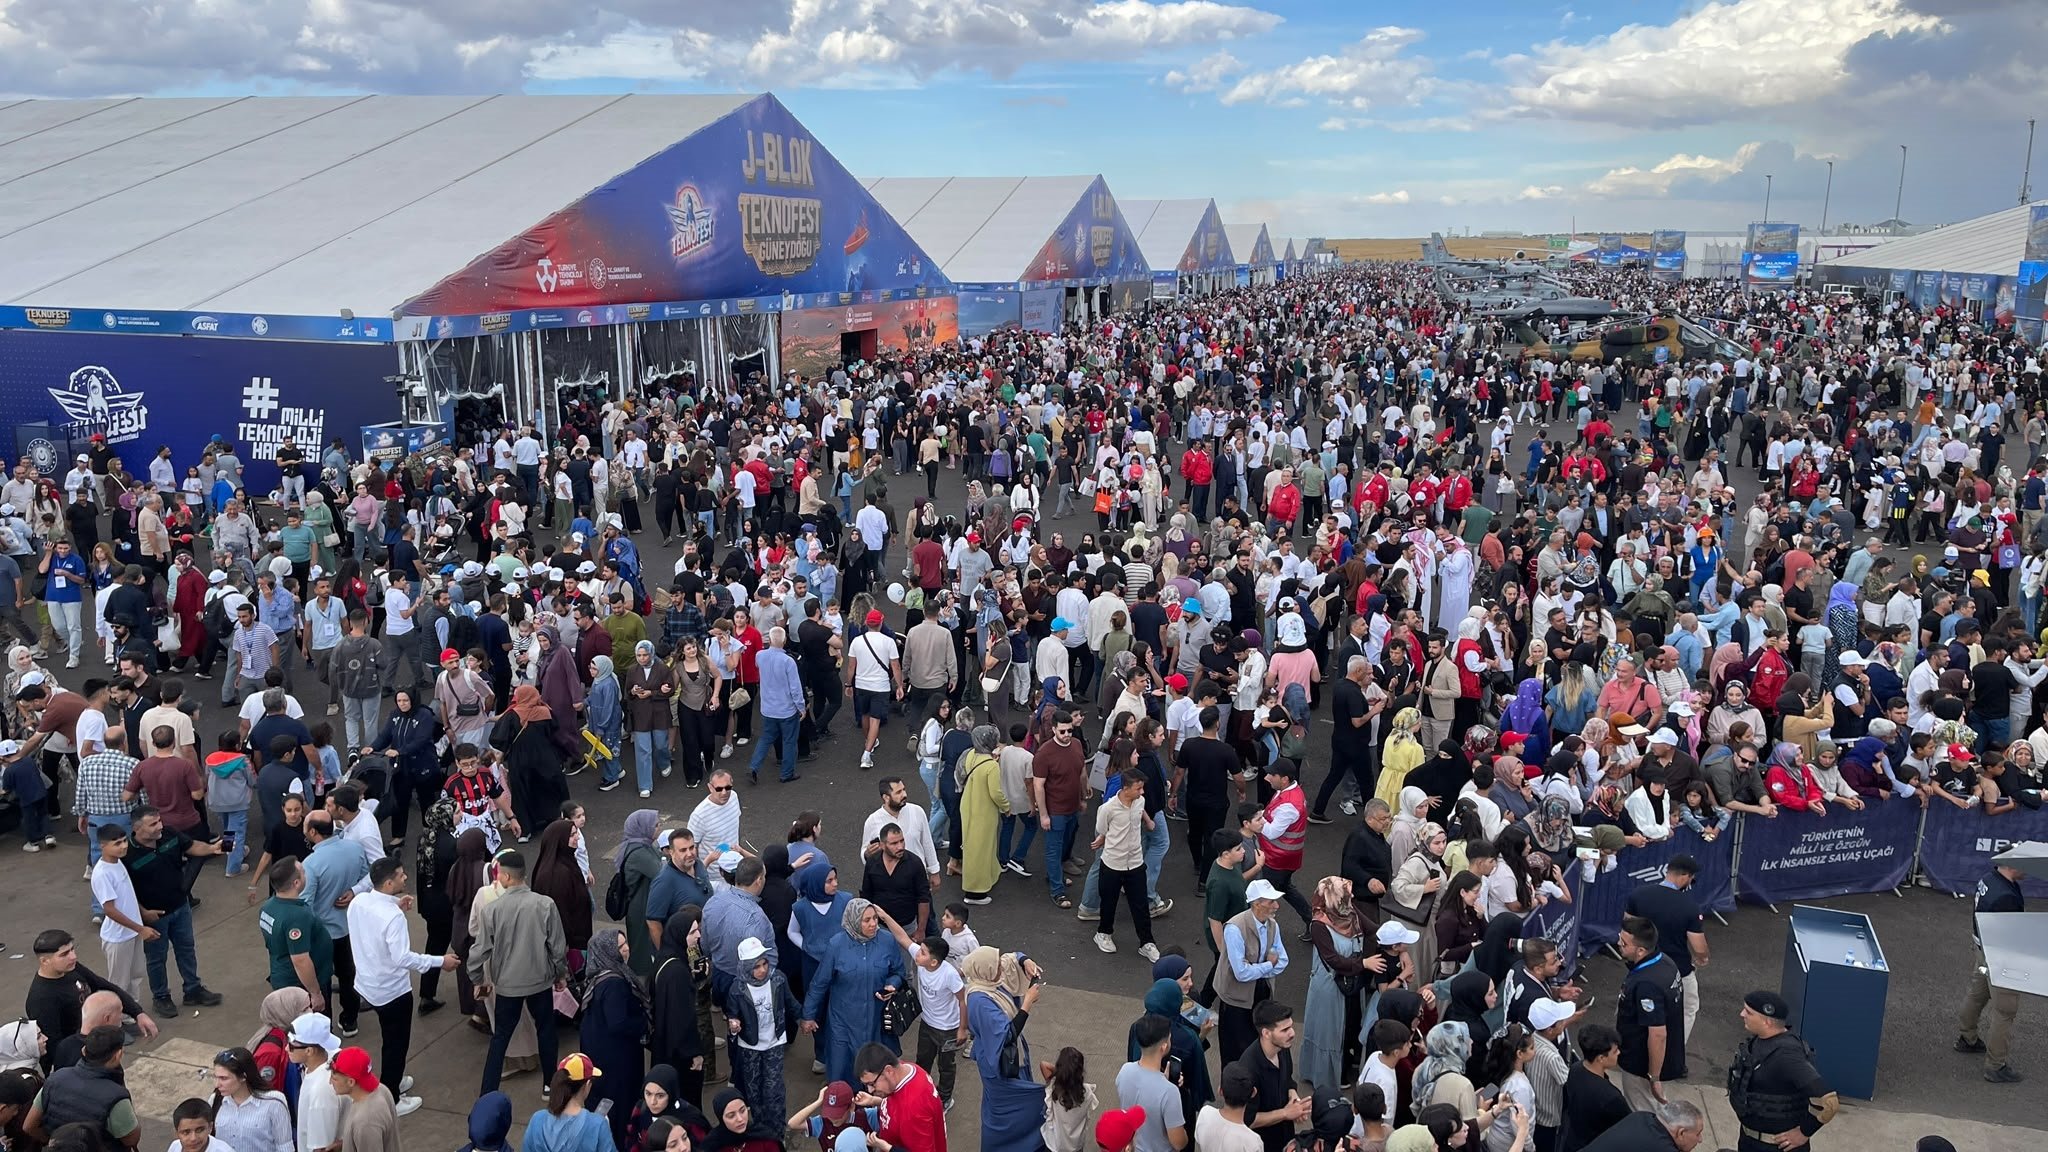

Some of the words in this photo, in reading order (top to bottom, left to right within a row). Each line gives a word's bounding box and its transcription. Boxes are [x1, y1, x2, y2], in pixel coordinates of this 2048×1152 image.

[742, 130, 815, 187] J-BLOK
[740, 197, 821, 234] TEKNOFEST
[673, 219, 714, 255] TEKNOFEST
[759, 237, 813, 262] GÜNEYDOĞU
[27, 309, 71, 319] TEKNOFEST
[196, 322, 218, 332] ASFAT
[411, 323, 423, 338] J1
[280, 407, 324, 427] MİLLİ
[238, 422, 323, 445] TEKNOLOJİ
[371, 447, 403, 456] TEKNOFEST
[1801, 826, 1865, 843] TÜRKİYE'NİN
[1789, 842, 1820, 855] MİLLİ
[1820, 843, 1834, 852] VE
[1834, 838, 1871, 850] ÖZGÜN
[1760, 859, 1779, 871] İLK
[1779, 854, 1827, 869] İNSANSIZ
[1828, 850, 1861, 863] SAVAŞ
[1863, 845, 1894, 860] UÇAĞI
